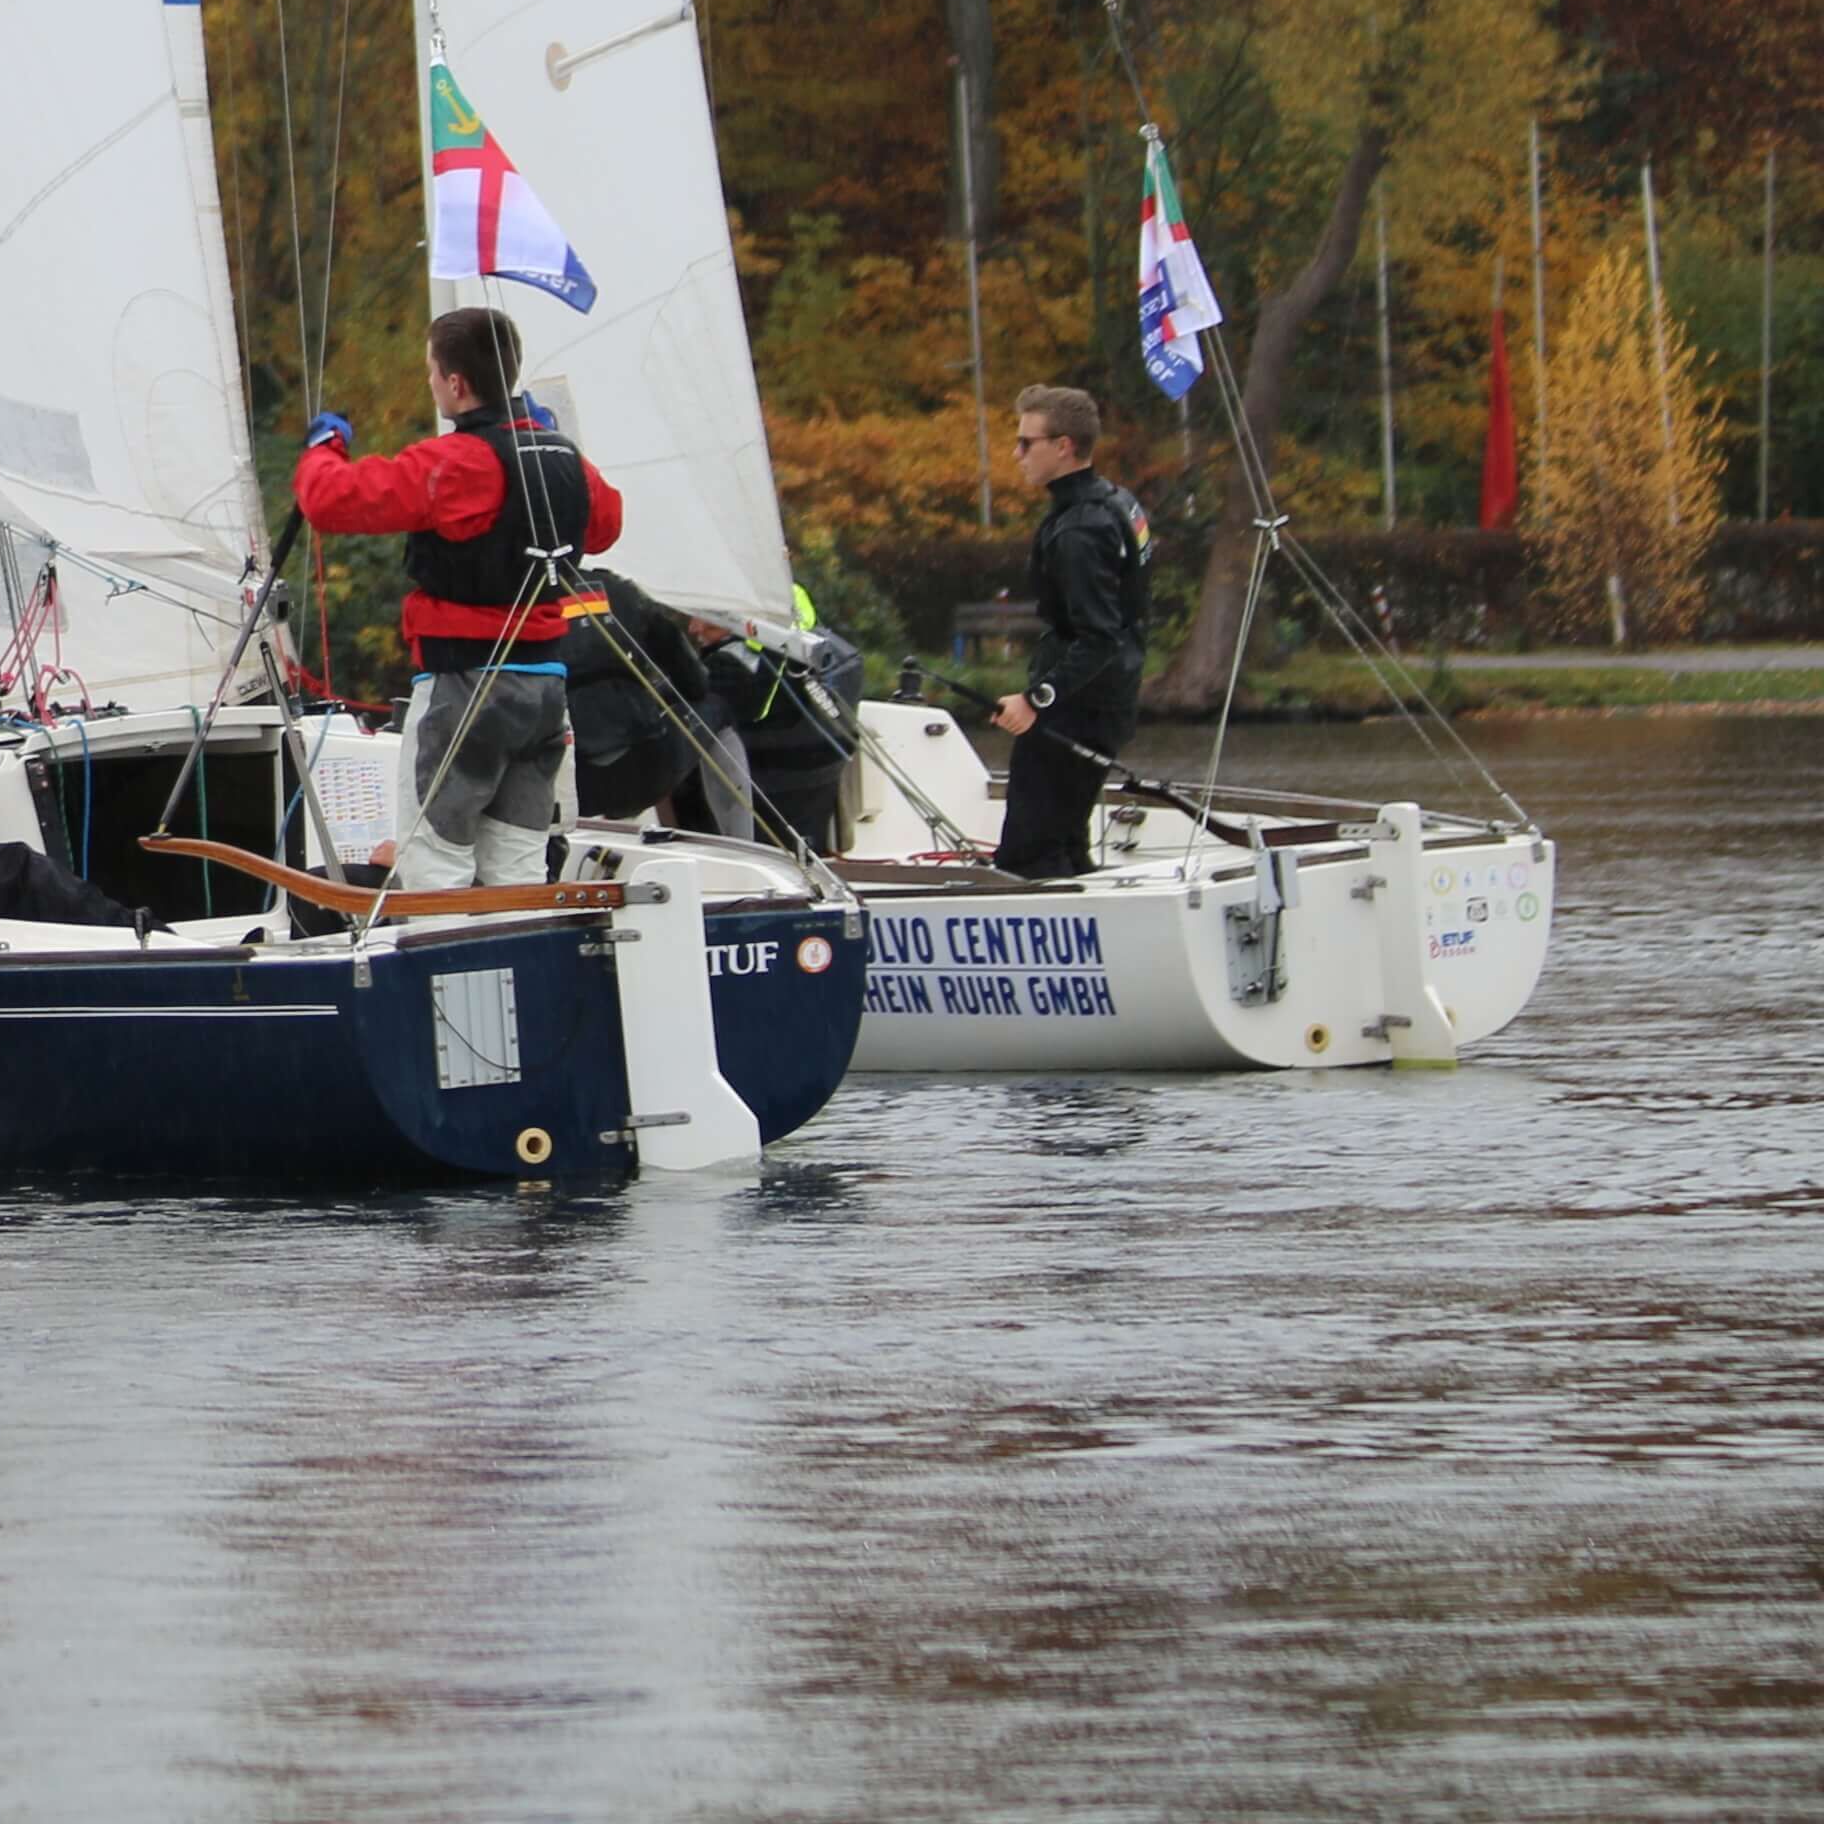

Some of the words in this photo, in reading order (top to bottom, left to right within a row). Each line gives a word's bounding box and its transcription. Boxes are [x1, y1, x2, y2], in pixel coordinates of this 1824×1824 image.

[703, 941, 779, 976] TUF
[866, 917, 935, 965] LVO
[945, 917, 1104, 965] CENTRUM
[862, 975, 934, 1014] HEIN
[938, 976, 1022, 1015] RUHR
[1028, 976, 1117, 1016] GMBH
